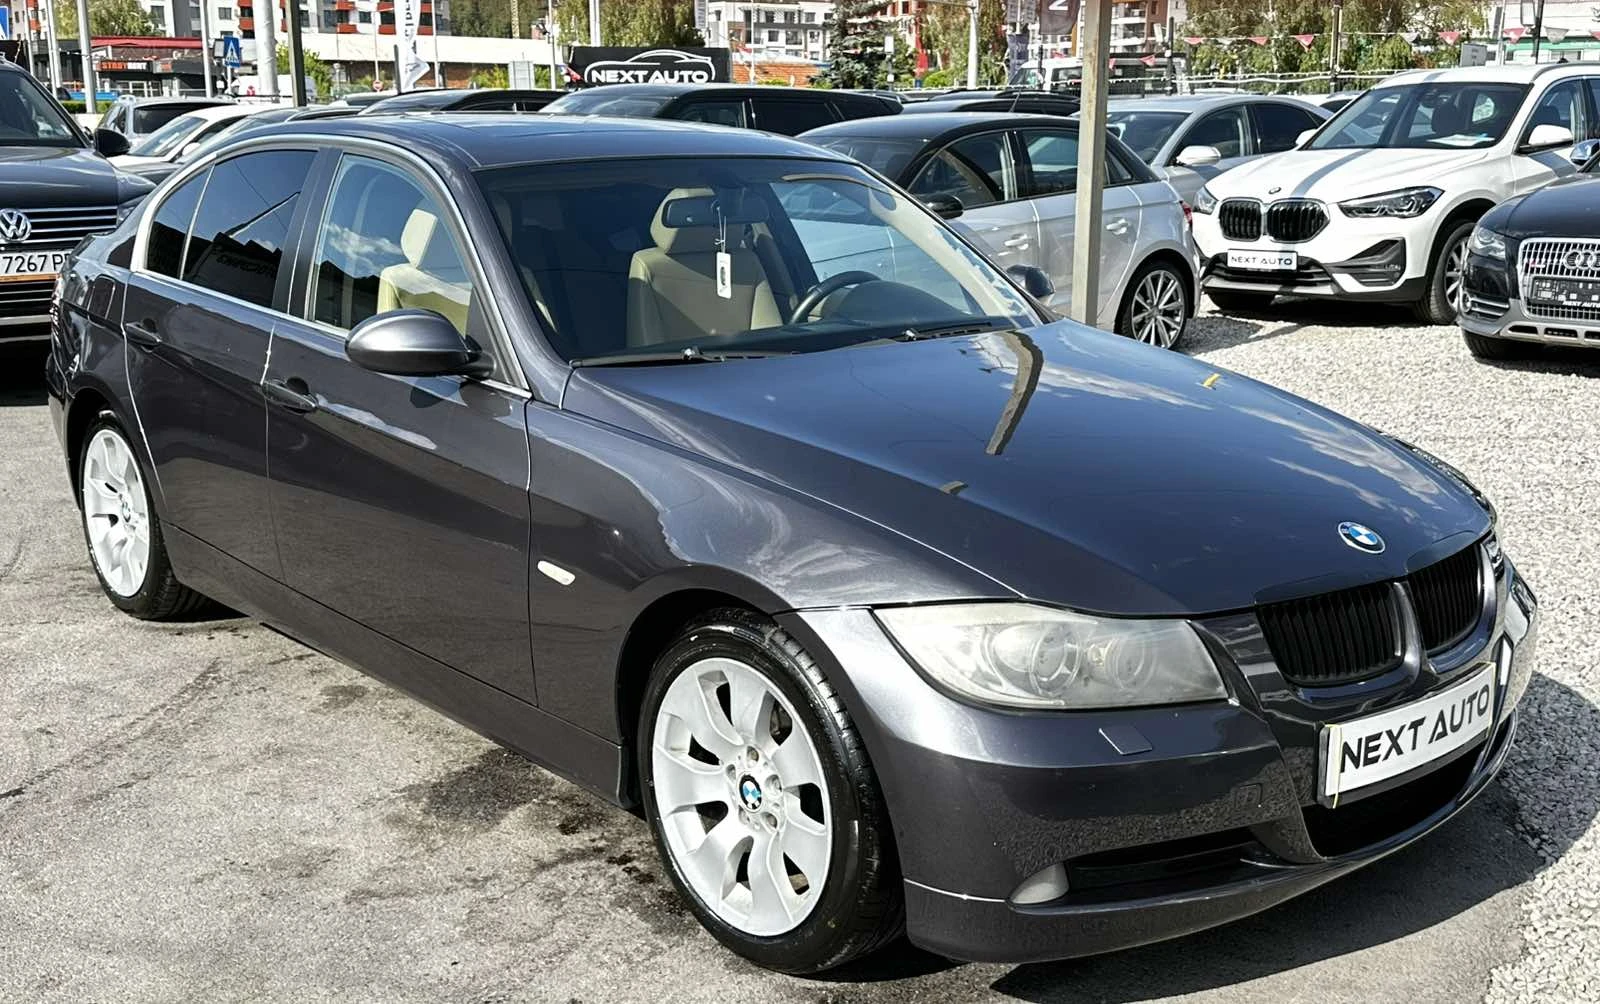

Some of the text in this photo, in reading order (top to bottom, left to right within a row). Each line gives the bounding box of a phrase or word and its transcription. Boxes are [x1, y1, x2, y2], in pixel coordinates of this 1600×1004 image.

[592, 70, 709, 83] NEXT AUTO
[3, 254, 48, 274] 7267
[1261, 257, 1293, 266] AUTO
[1340, 683, 1490, 774] NEXT AUTO
